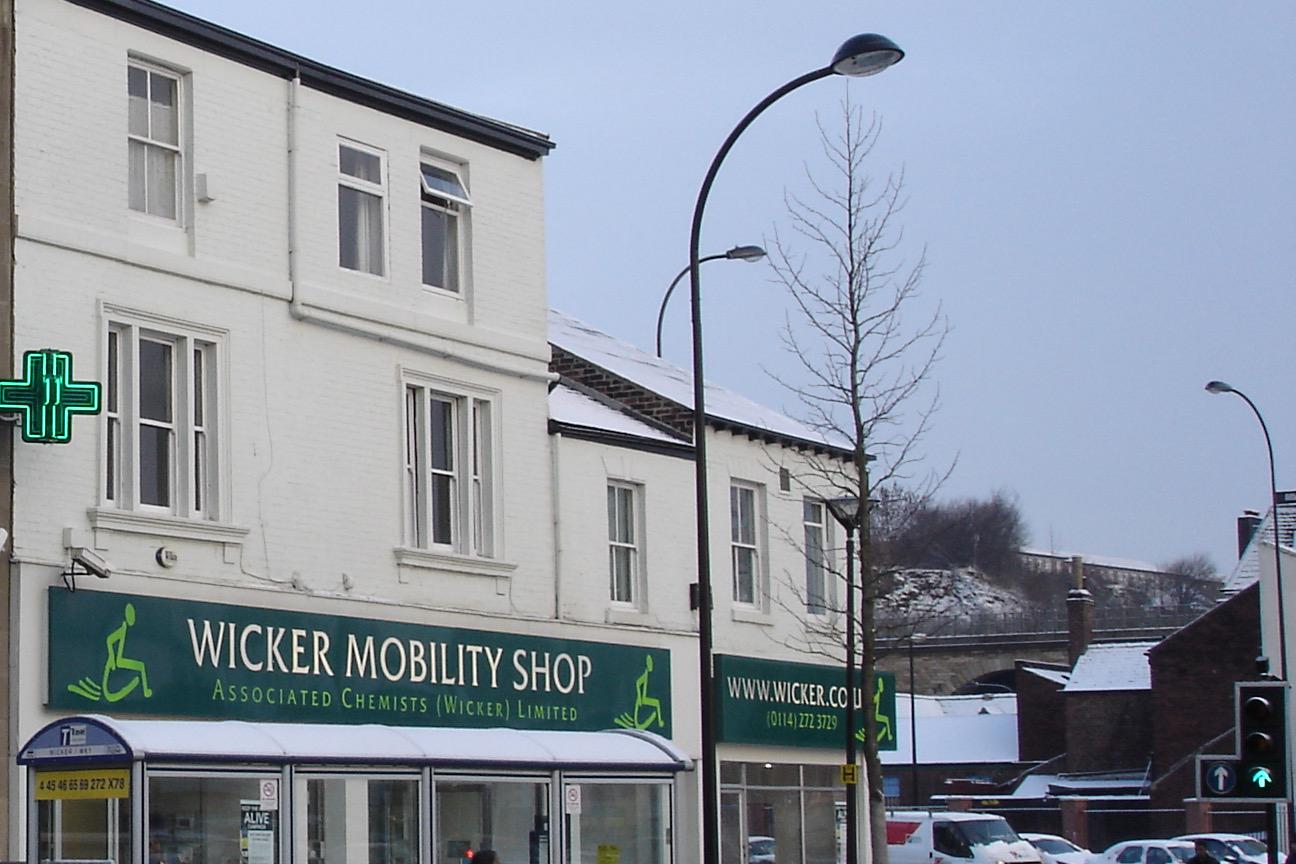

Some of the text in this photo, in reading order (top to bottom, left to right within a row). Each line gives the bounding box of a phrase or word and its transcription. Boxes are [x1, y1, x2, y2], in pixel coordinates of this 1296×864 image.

[186, 618, 592, 695] WICKER MOBILITY SHOP
[212, 679, 578, 722] ASSOCIATED CHEMISTS (WICKER) LIMITED
[727, 676, 862, 709] WWW.WICKER.COU
[767, 710, 838, 731] (0114) 272 3729
[46, 780, 56, 791] 45
[90, 778, 106, 790] 272
[107, 777, 125, 790] X78
[244, 812, 270, 824] ALIVE
